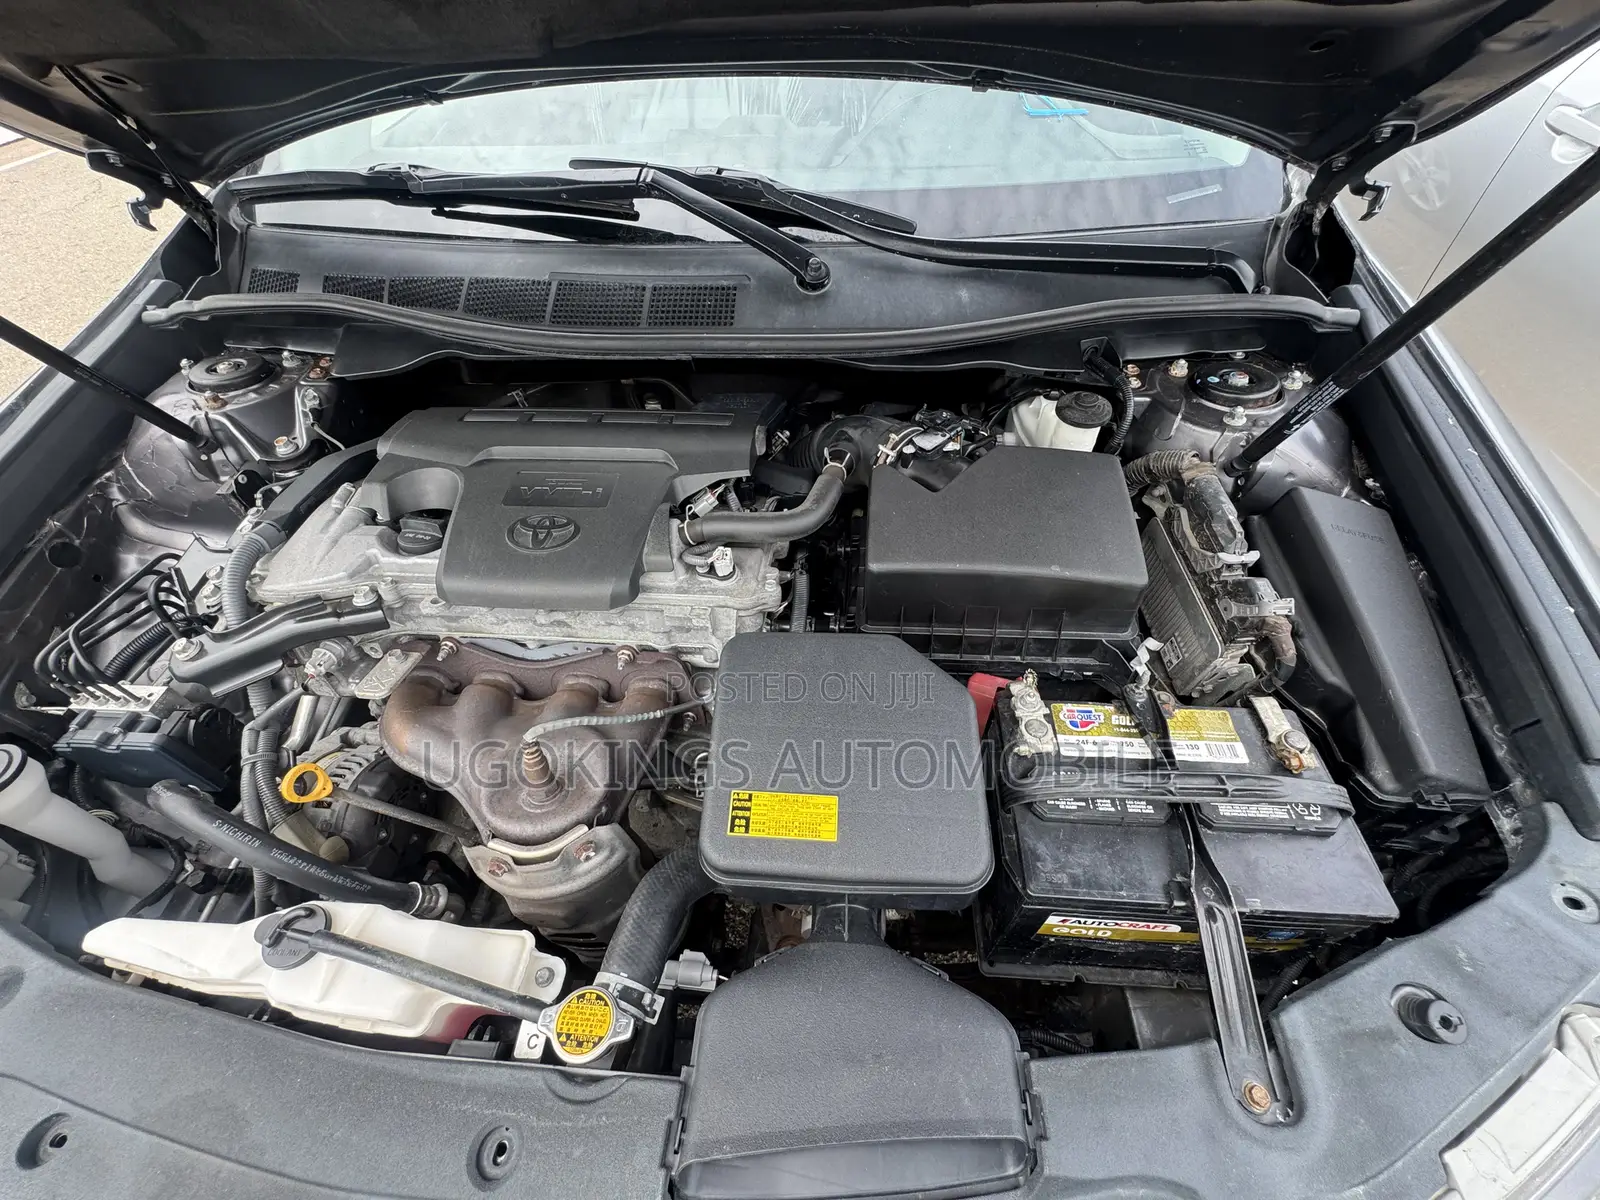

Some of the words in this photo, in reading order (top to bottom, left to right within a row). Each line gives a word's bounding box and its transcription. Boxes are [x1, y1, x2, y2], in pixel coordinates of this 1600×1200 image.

[1184, 743, 1200, 751] 130
[1069, 919, 1171, 931] AUTOCRAFT
[1052, 926, 1113, 937] GOLD
[579, 998, 605, 1006] CAUTION
[527, 1033, 539, 1050] C
